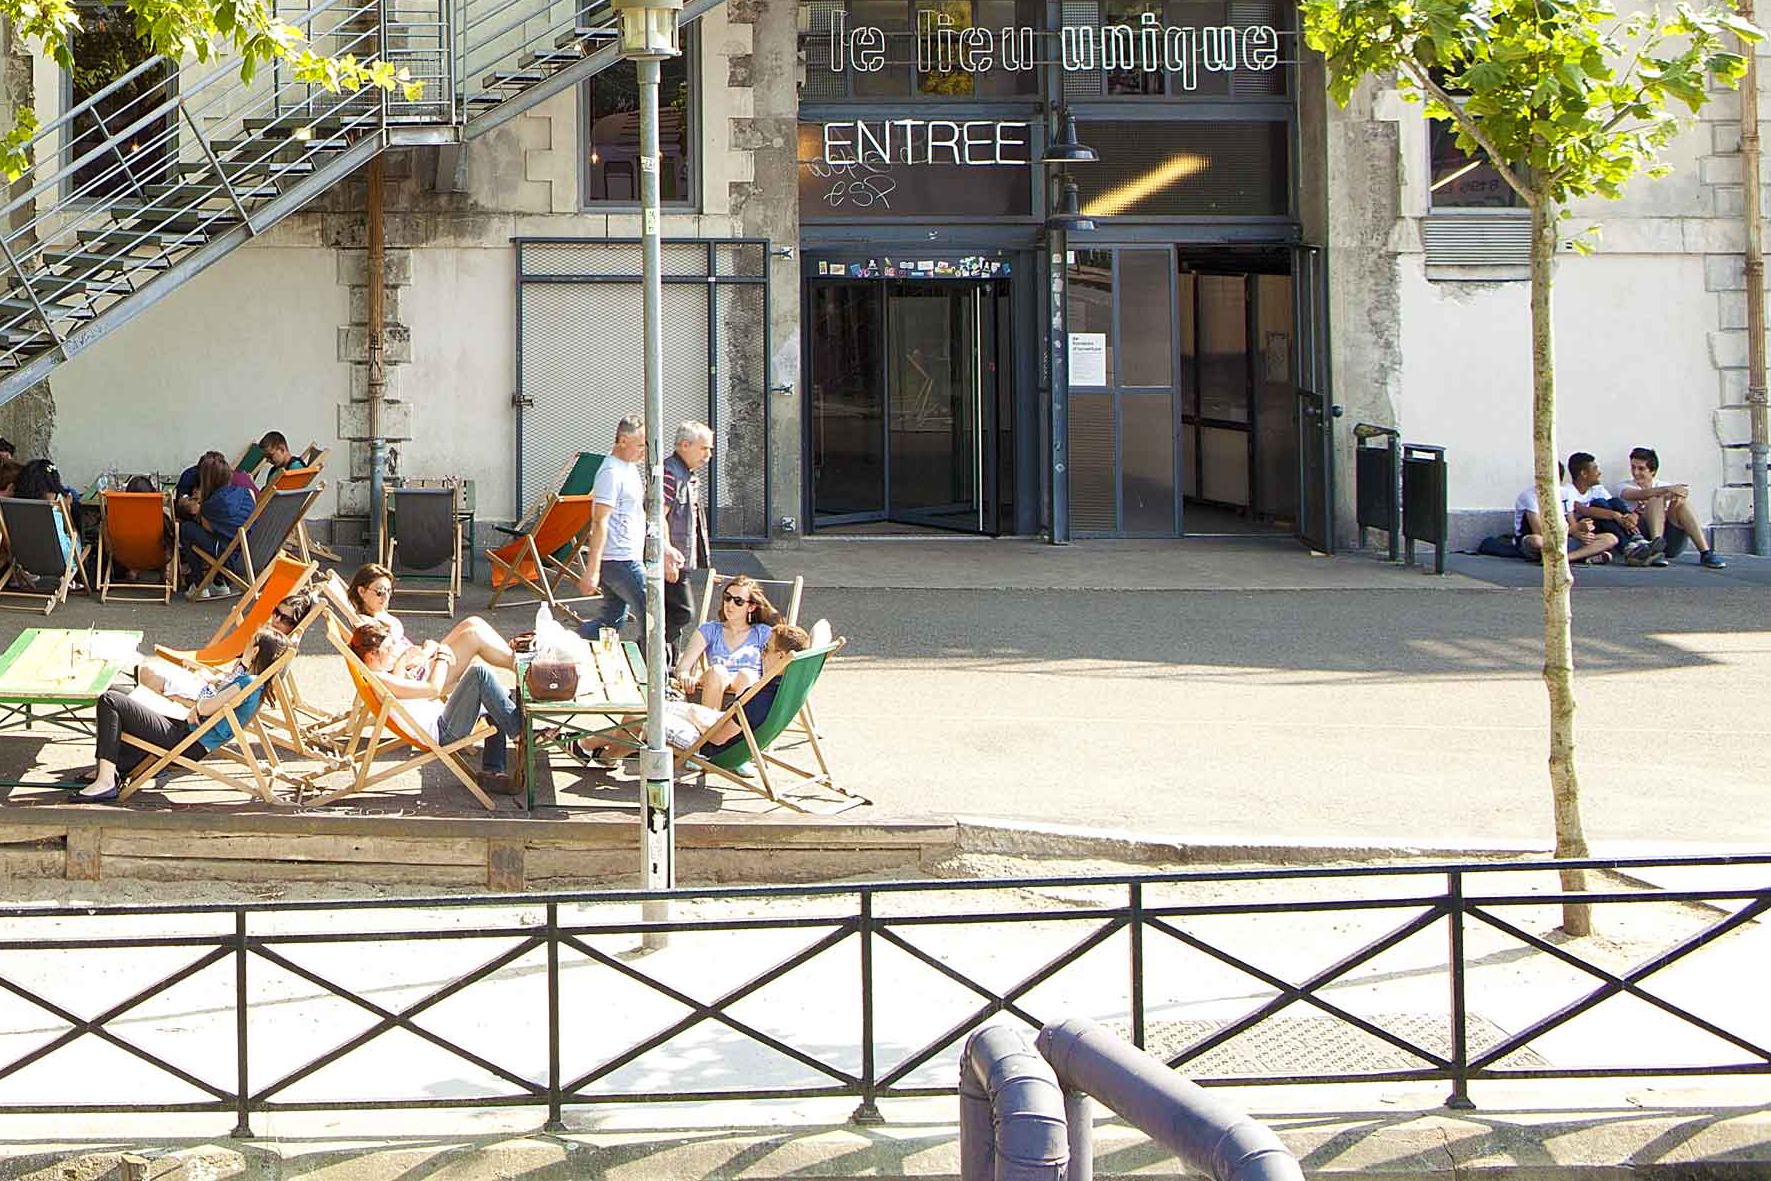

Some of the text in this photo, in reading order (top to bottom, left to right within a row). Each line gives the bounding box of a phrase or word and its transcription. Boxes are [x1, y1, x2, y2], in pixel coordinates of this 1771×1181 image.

[830, 9, 1279, 91] le lieu unique
[824, 120, 1029, 166] ENTREE
